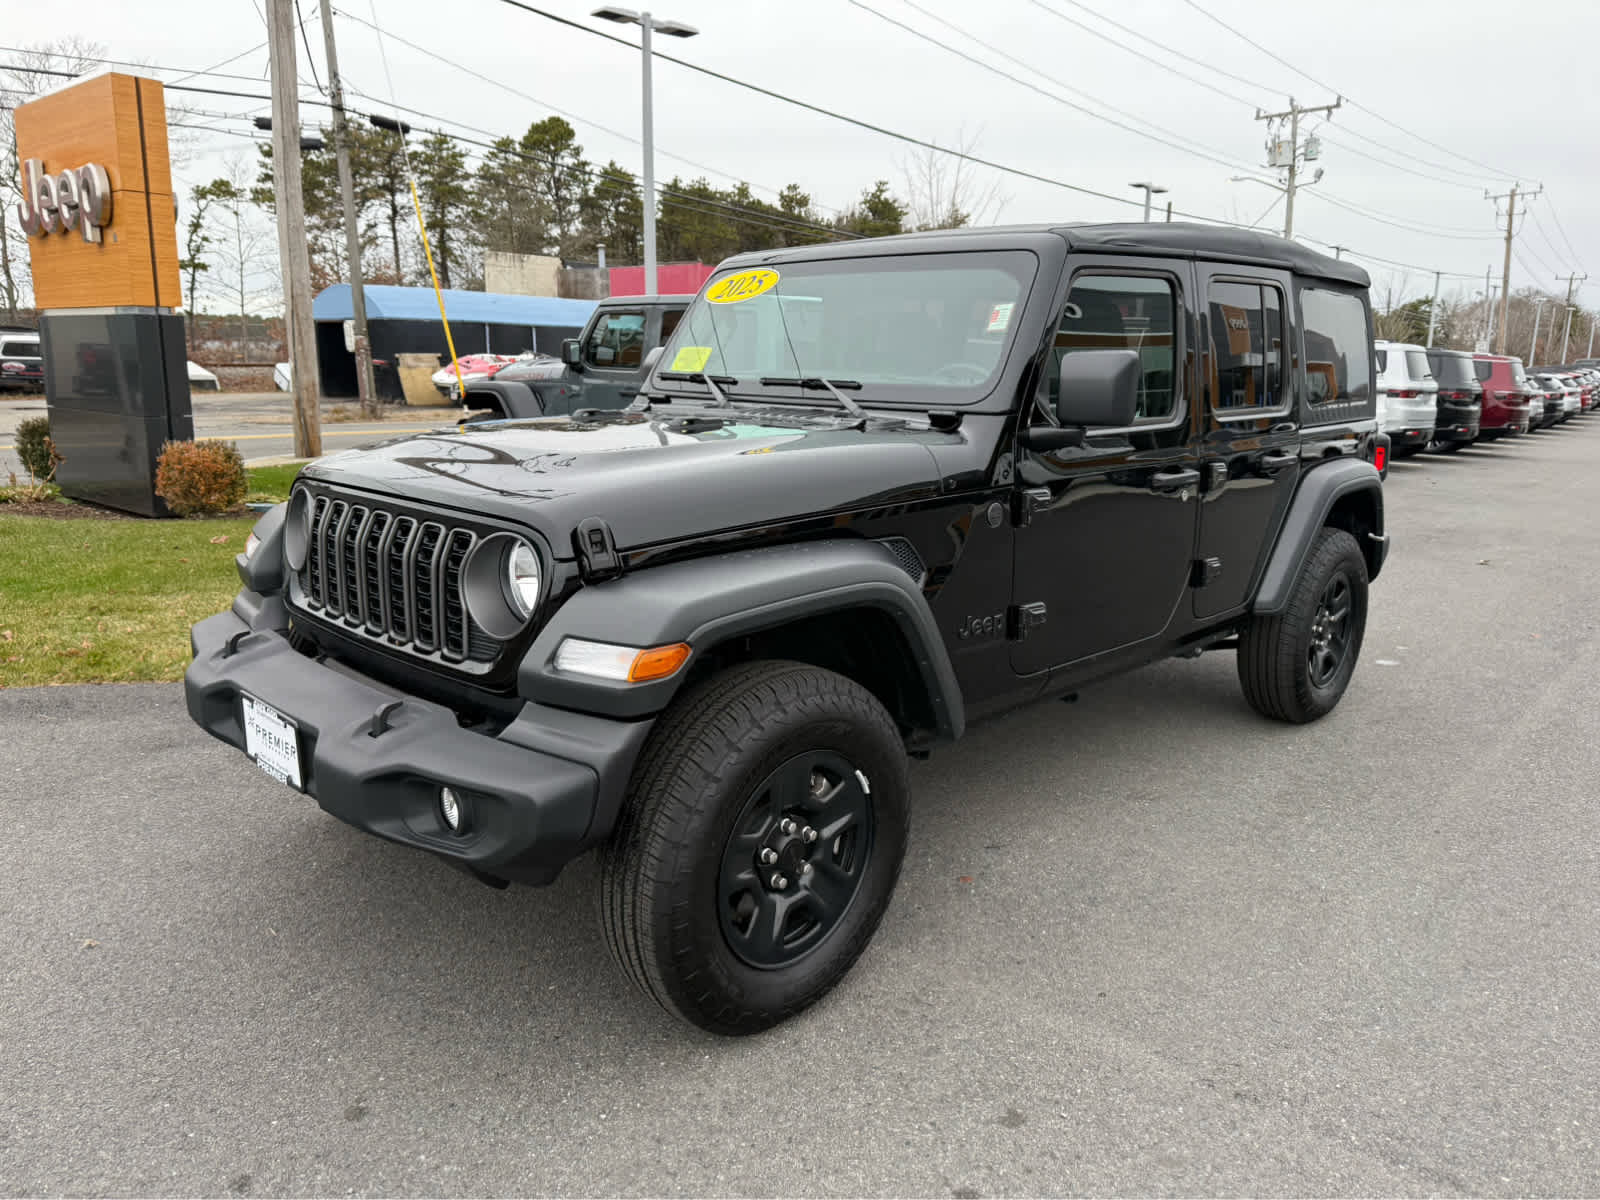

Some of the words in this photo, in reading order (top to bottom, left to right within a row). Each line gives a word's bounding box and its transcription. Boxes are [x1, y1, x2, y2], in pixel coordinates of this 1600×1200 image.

[18, 158, 112, 243] Jeep
[714, 273, 771, 299] 2025
[959, 613, 1004, 640] Jeep
[255, 724, 297, 758] PREMIER
